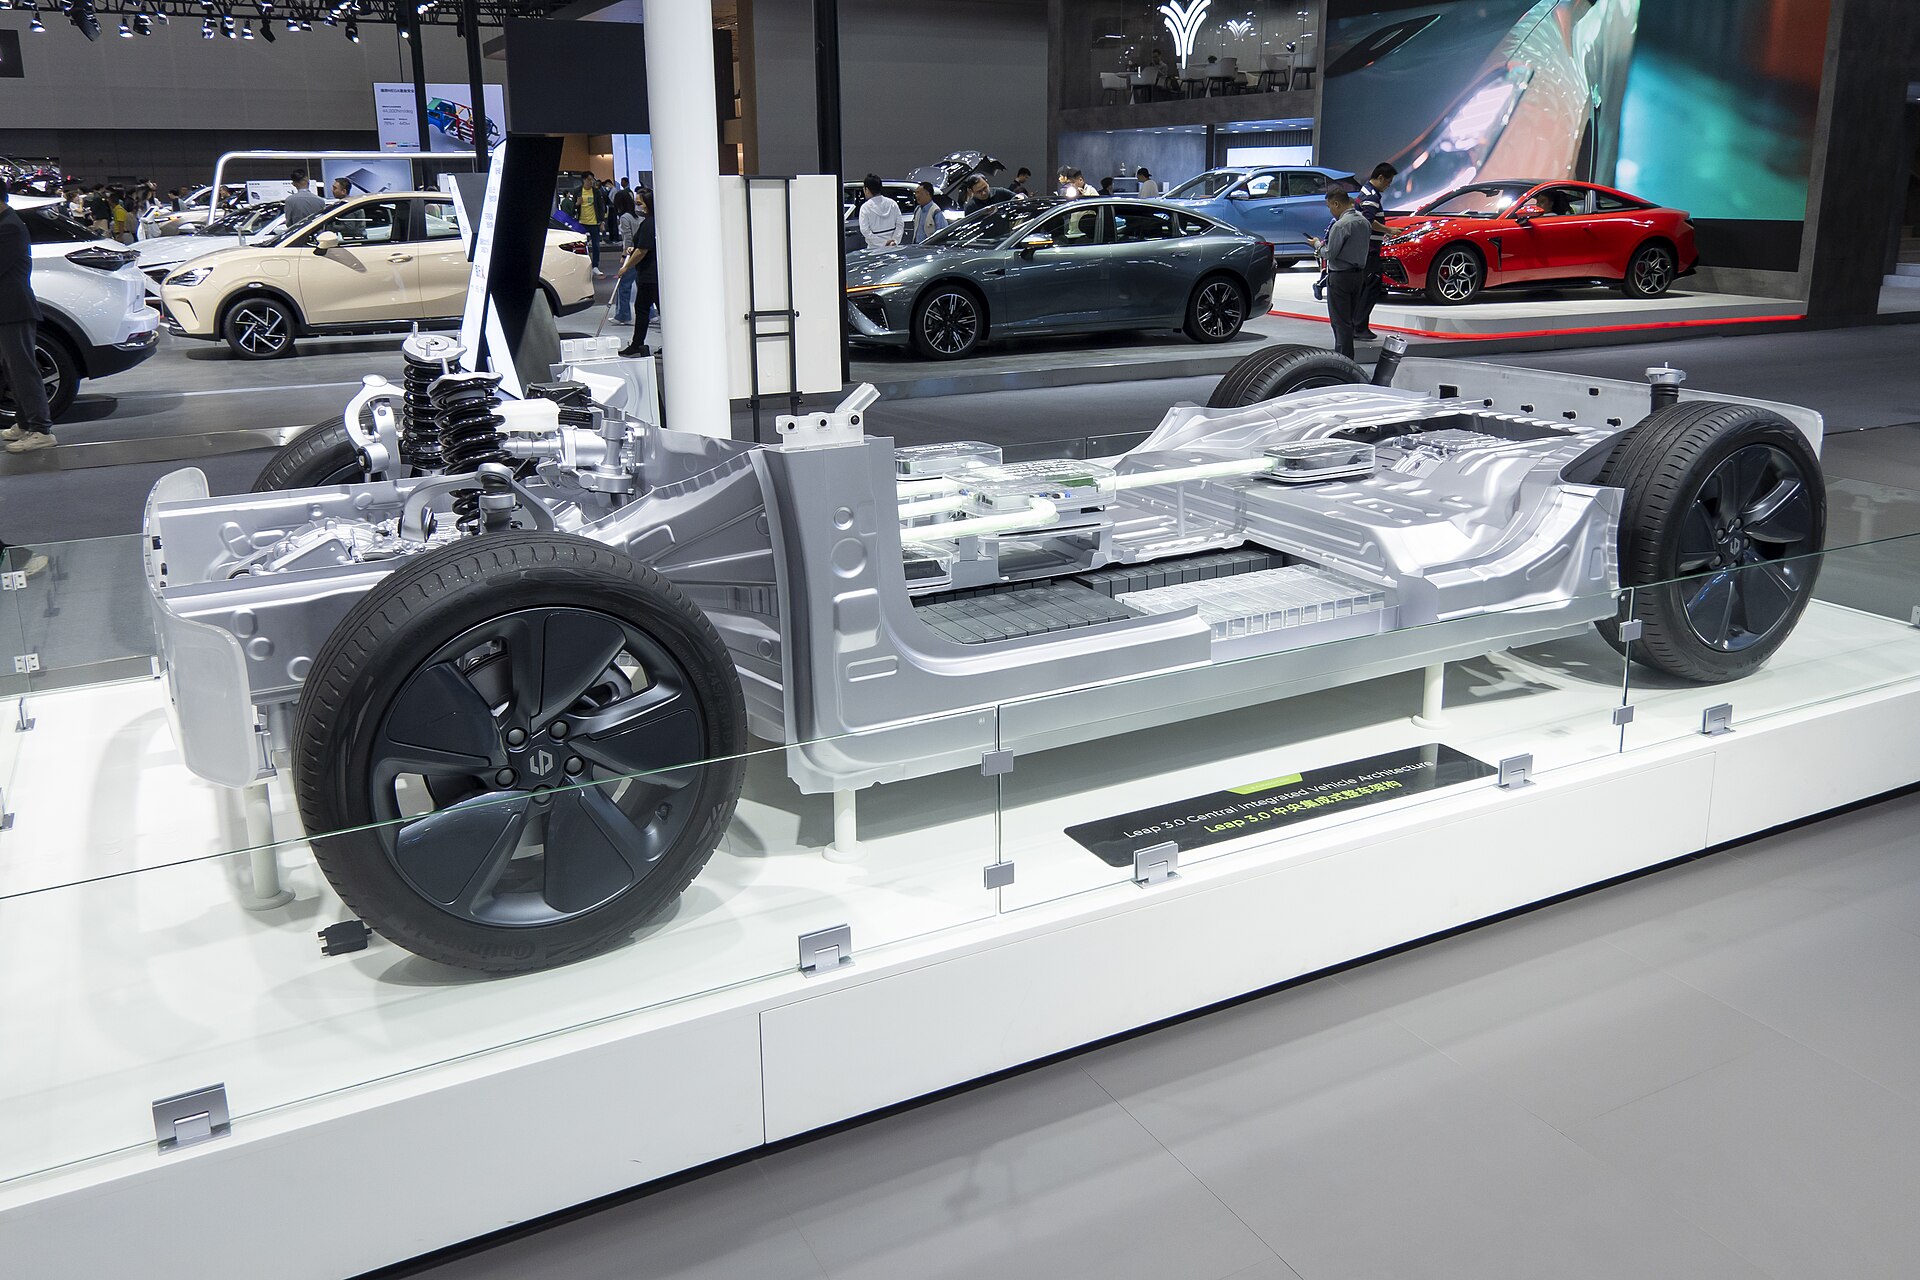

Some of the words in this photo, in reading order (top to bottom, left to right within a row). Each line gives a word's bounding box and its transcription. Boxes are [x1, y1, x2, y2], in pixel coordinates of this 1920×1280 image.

[1123, 825, 1162, 838] Leap
[1161, 819, 1186, 829] 3.0
[1186, 806, 1238, 823] Central
[1238, 788, 1310, 810] Integrated
[1308, 778, 1358, 793] Vehicle
[1358, 761, 1434, 782] Architecture
[1204, 820, 1245, 833] Leap
[1244, 812, 1271, 822] 3.0
[1270, 780, 1403, 816] 中央集成式整车架构
